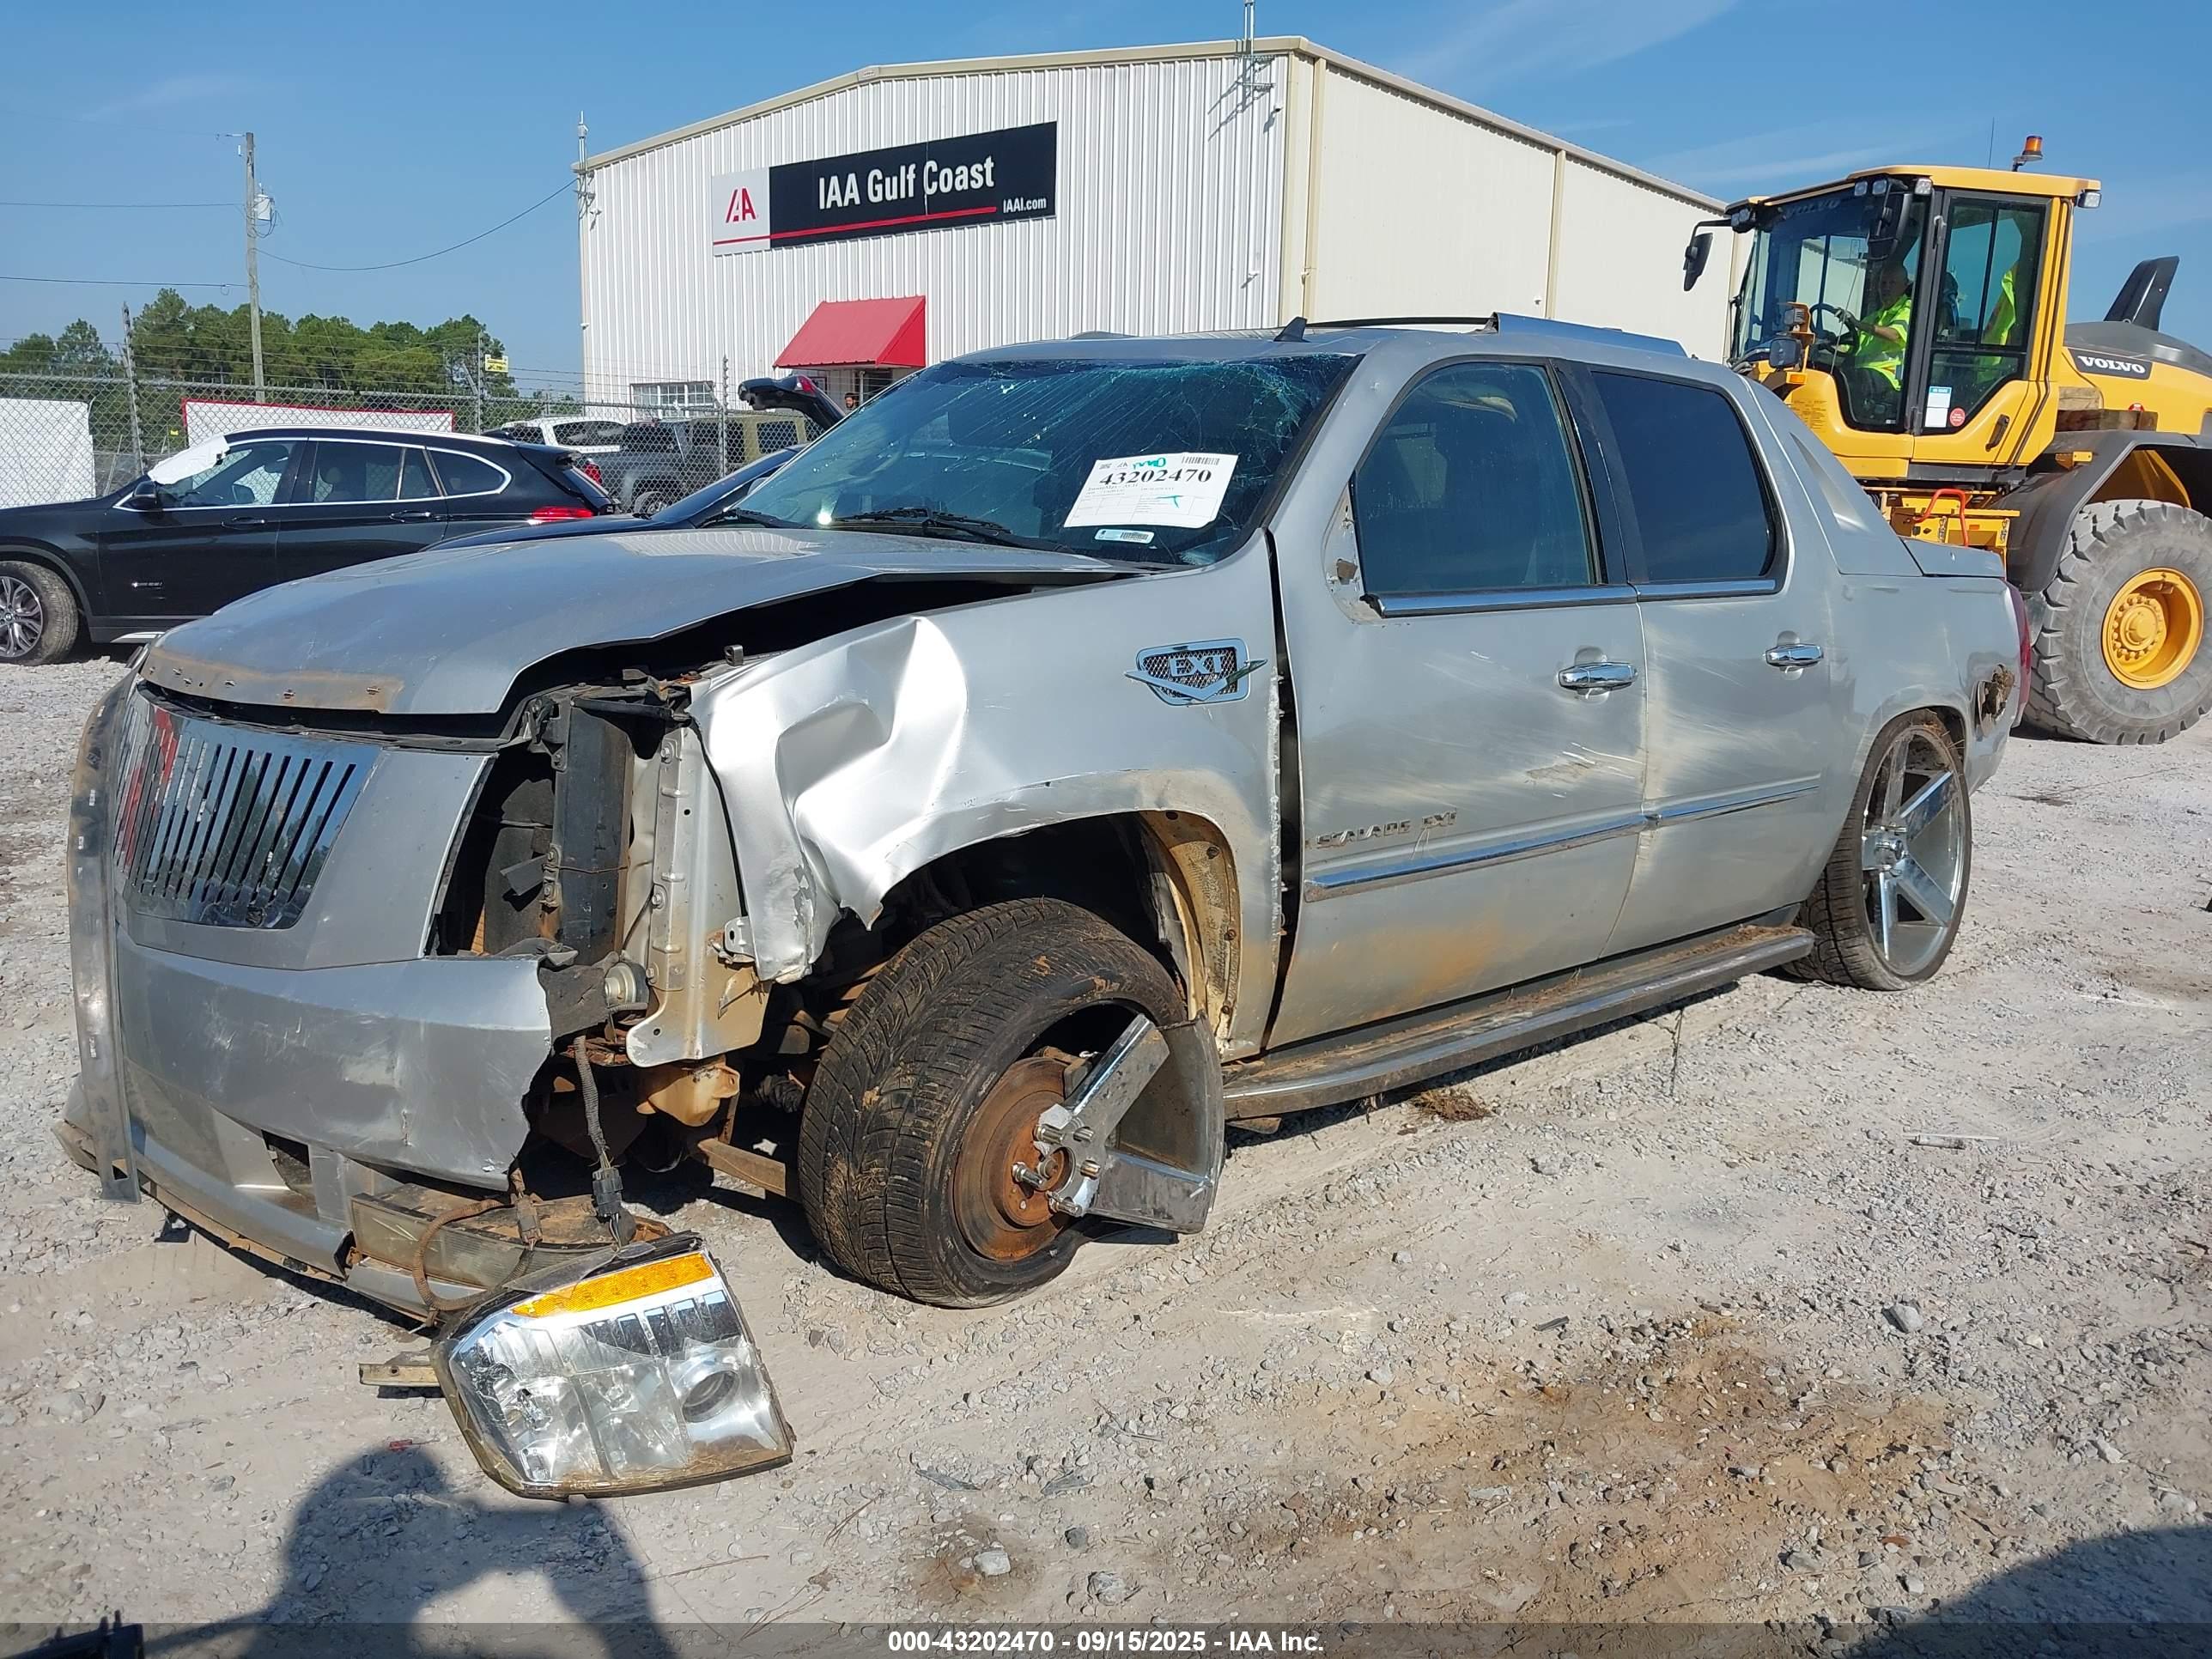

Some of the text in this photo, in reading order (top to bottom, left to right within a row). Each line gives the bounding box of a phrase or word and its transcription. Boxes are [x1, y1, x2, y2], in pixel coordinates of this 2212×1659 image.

[818, 155, 994, 210] IAA Gulf Coast
[1003, 197, 1047, 214] IAAI.com
[2077, 356, 2146, 374] VOLVO
[1099, 469, 1212, 486] 43202470
[1169, 654, 1225, 678] EXT
